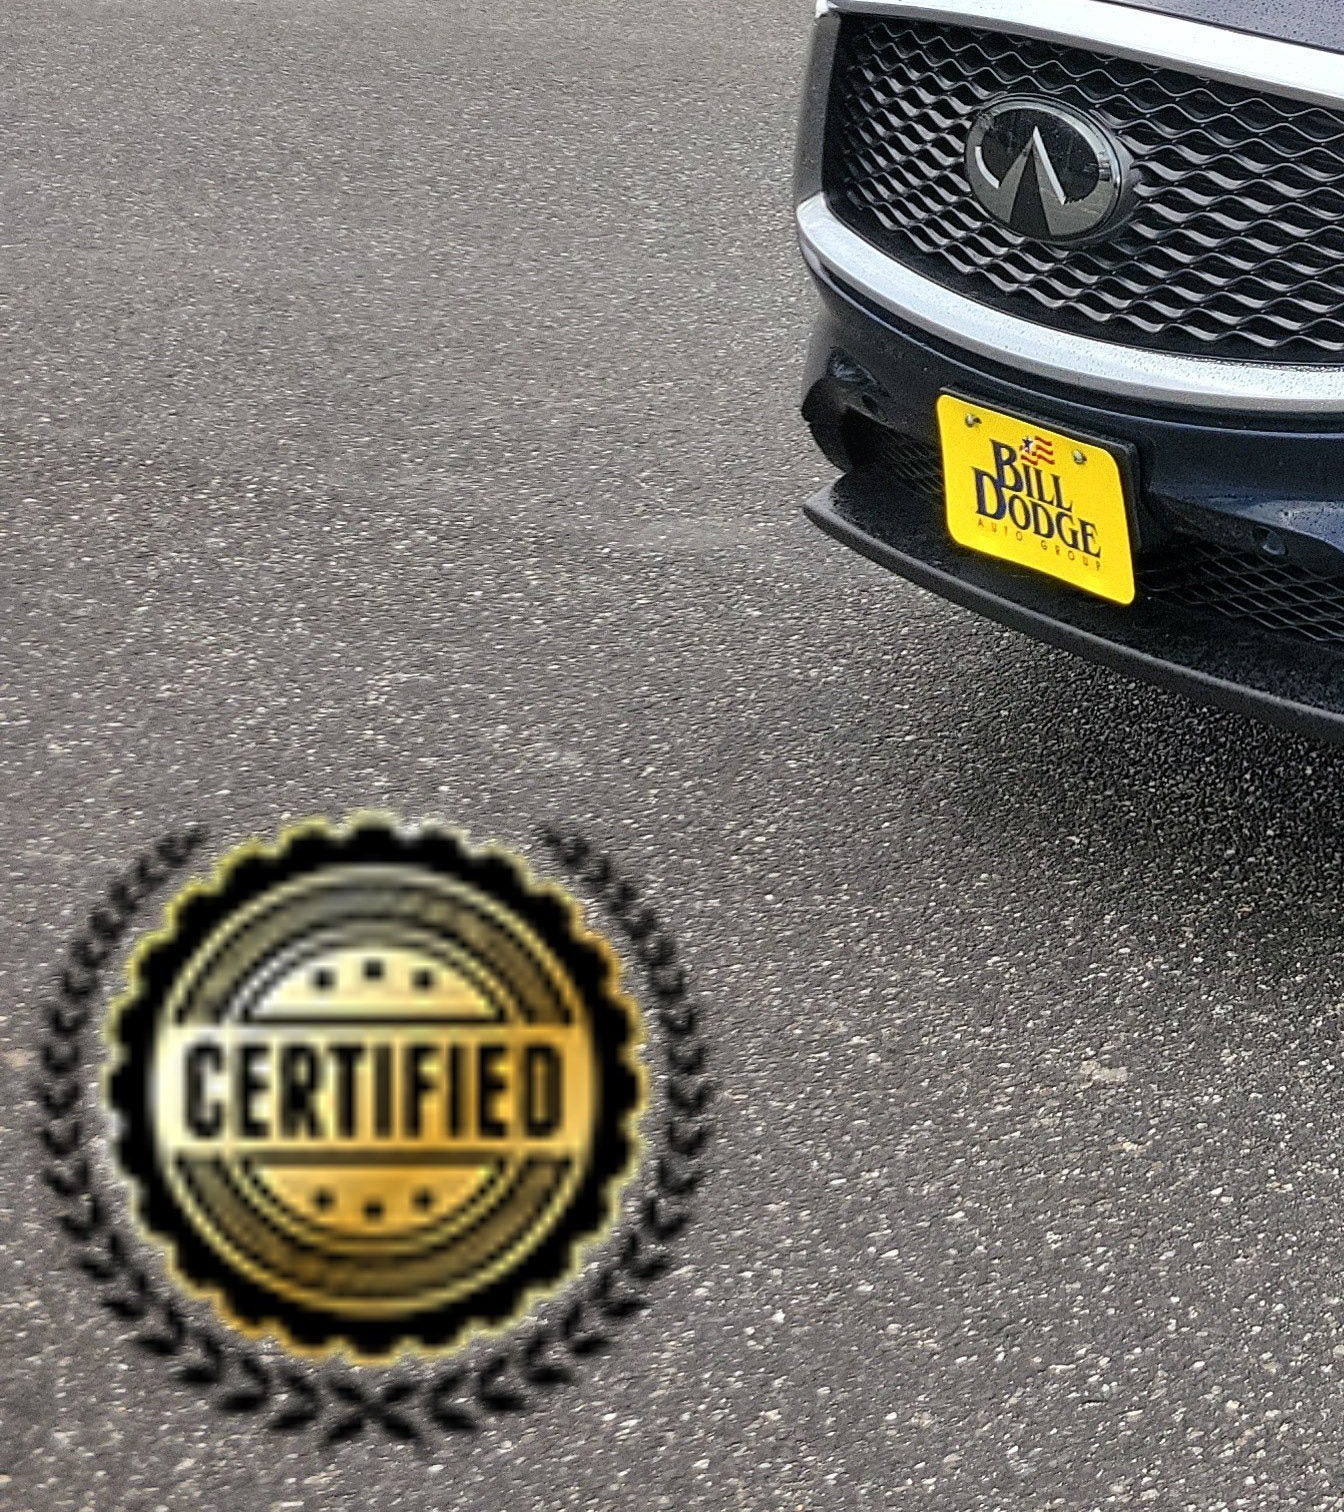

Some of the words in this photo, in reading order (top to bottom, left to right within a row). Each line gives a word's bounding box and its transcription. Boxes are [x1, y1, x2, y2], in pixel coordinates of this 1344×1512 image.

[972, 466, 1102, 559] DODGE
[989, 438, 1073, 513] BILL
[977, 519, 1024, 541] AUTO
[1040, 540, 1101, 570] GROUP
